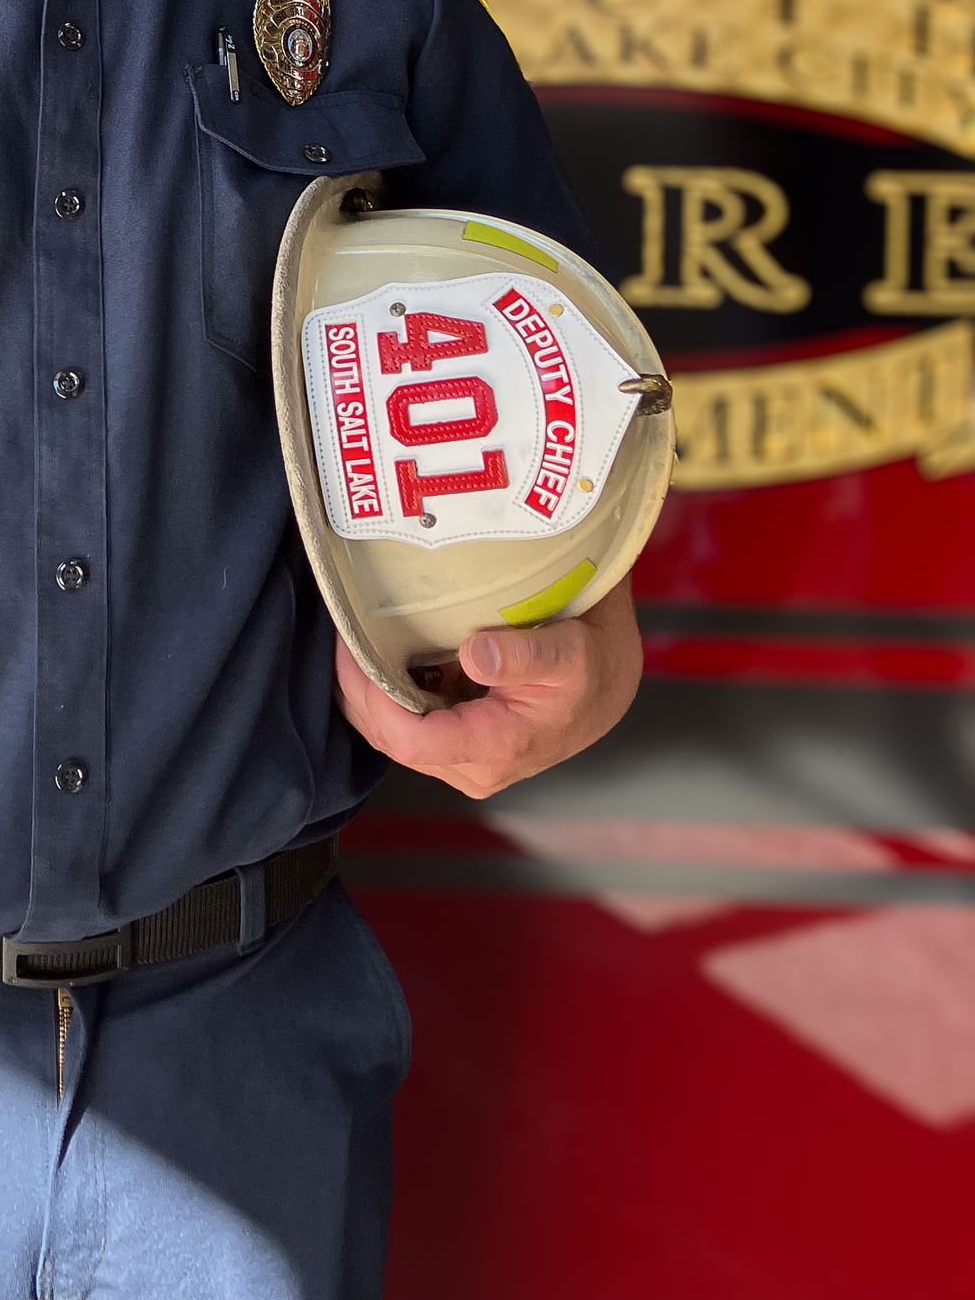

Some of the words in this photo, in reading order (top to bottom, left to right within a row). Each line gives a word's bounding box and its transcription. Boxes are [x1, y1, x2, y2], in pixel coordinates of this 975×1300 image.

[327, 326, 361, 396] SOUTH
[502, 298, 573, 406] DEPUTY
[336, 401, 369, 452] SALT
[376, 311, 510, 518] 401
[344, 457, 380, 515] LAKE
[532, 419, 576, 513] CHIEF
